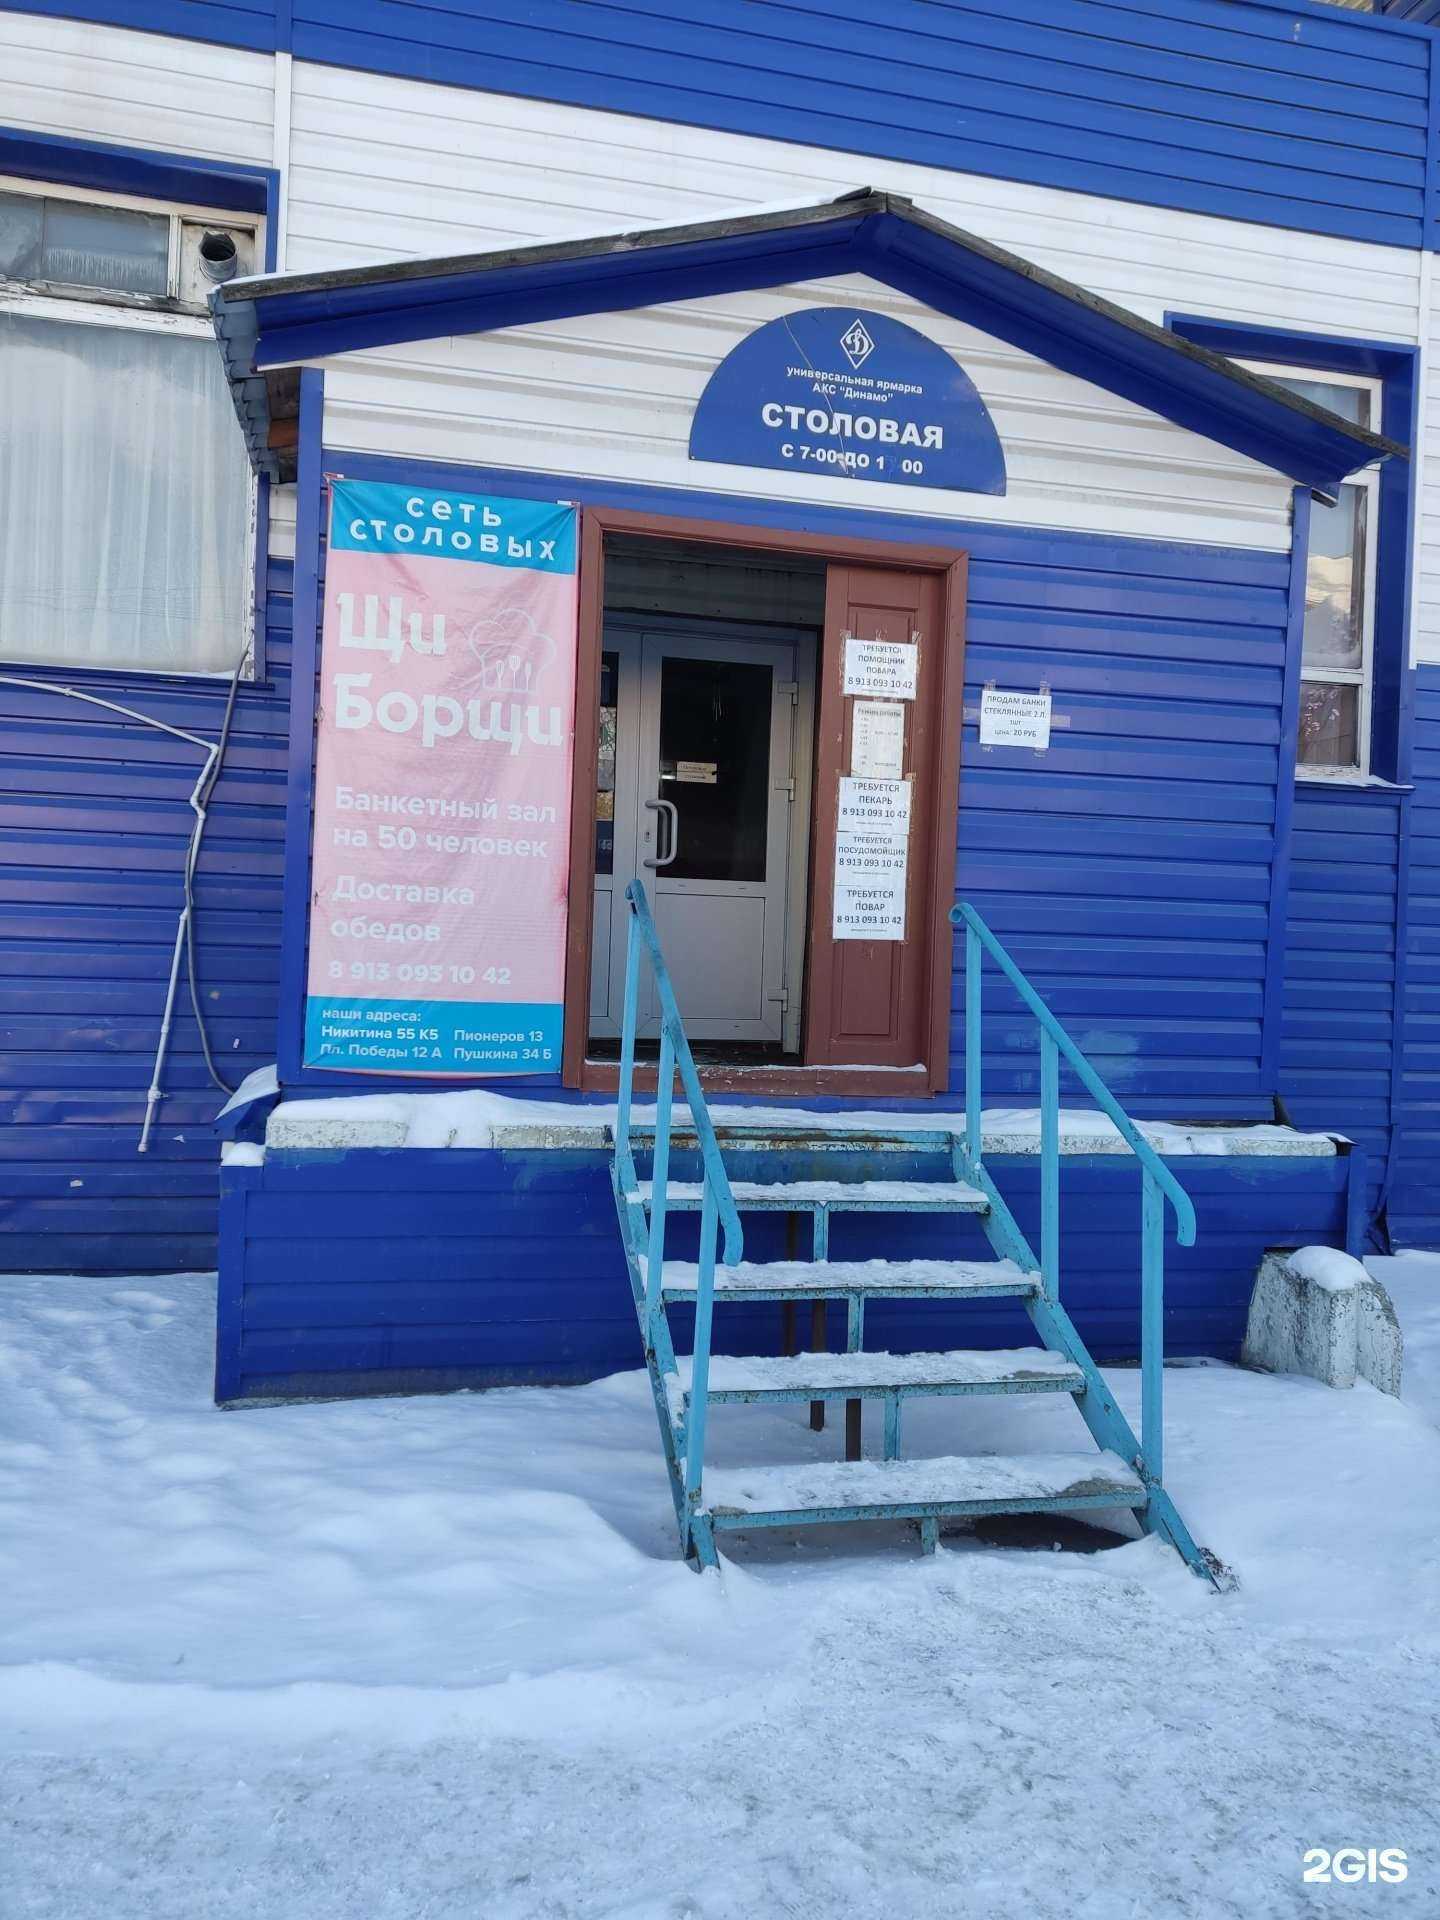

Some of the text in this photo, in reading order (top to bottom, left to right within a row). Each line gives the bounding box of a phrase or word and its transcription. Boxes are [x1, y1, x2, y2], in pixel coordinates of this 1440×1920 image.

[786, 366, 923, 394] универсальная ярмарка
[812, 382, 836, 394] АКС
[761, 402, 943, 449] СТОЛОВАЯ
[781, 443, 794, 457] С
[800, 445, 837, 463] 7-00
[845, 452, 870, 469] ДО
[406, 497, 501, 526] сеть
[350, 519, 556, 560] столовых
[337, 592, 447, 663] Щи
[863, 644, 902, 654] ТРЕБУЕТСЯ
[858, 654, 905, 665] ПОМОЩНИК
[866, 666, 896, 675] ПОВАРА
[856, 677, 870, 685] 913
[873, 678, 888, 687] 093
[891, 680, 900, 688] 10
[902, 681, 912, 689] 42
[987, 695, 1046, 706] ПРОДАМ БАНКИ
[333, 672, 563, 756] Борщи
[984, 707, 1032, 716] СТЕКЛЯННЫЕ
[853, 782, 900, 792] ТРЕБУЕТСЯ
[335, 785, 556, 823] Банкетный зал
[859, 795, 893, 805] ПЕКАРЬ
[850, 808, 865, 816] 913
[868, 809, 882, 817] 093
[885, 810, 895, 818] 10
[333, 825, 548, 858] на 50 человек
[853, 836, 892, 844] ТРЕБУЕТСЯ
[838, 846, 906, 856] ПОСУДОМОЙЩИК
[839, 858, 844, 866] 8
[846, 858, 861, 866] 913
[864, 859, 879, 867] 093
[894, 860, 904, 868] 42
[331, 875, 475, 905] Доставка
[847, 889, 894, 899] ТРЕБУЕТСЯ
[855, 902, 885, 911] ПОВАР
[837, 915, 902, 924] 8 913 093 10 42
[330, 915, 441, 943] обедов
[328, 960, 511, 985] 8 913 093 10 42
[322, 1009, 421, 1023] наши адреса:
[322, 1025, 439, 1040] Никитина 55 К5
[454, 1029, 543, 1044] Пионеров 13
[320, 1043, 442, 1058] Пл. Победы 12 А
[454, 1047, 552, 1061] Пушкина 34 Б
